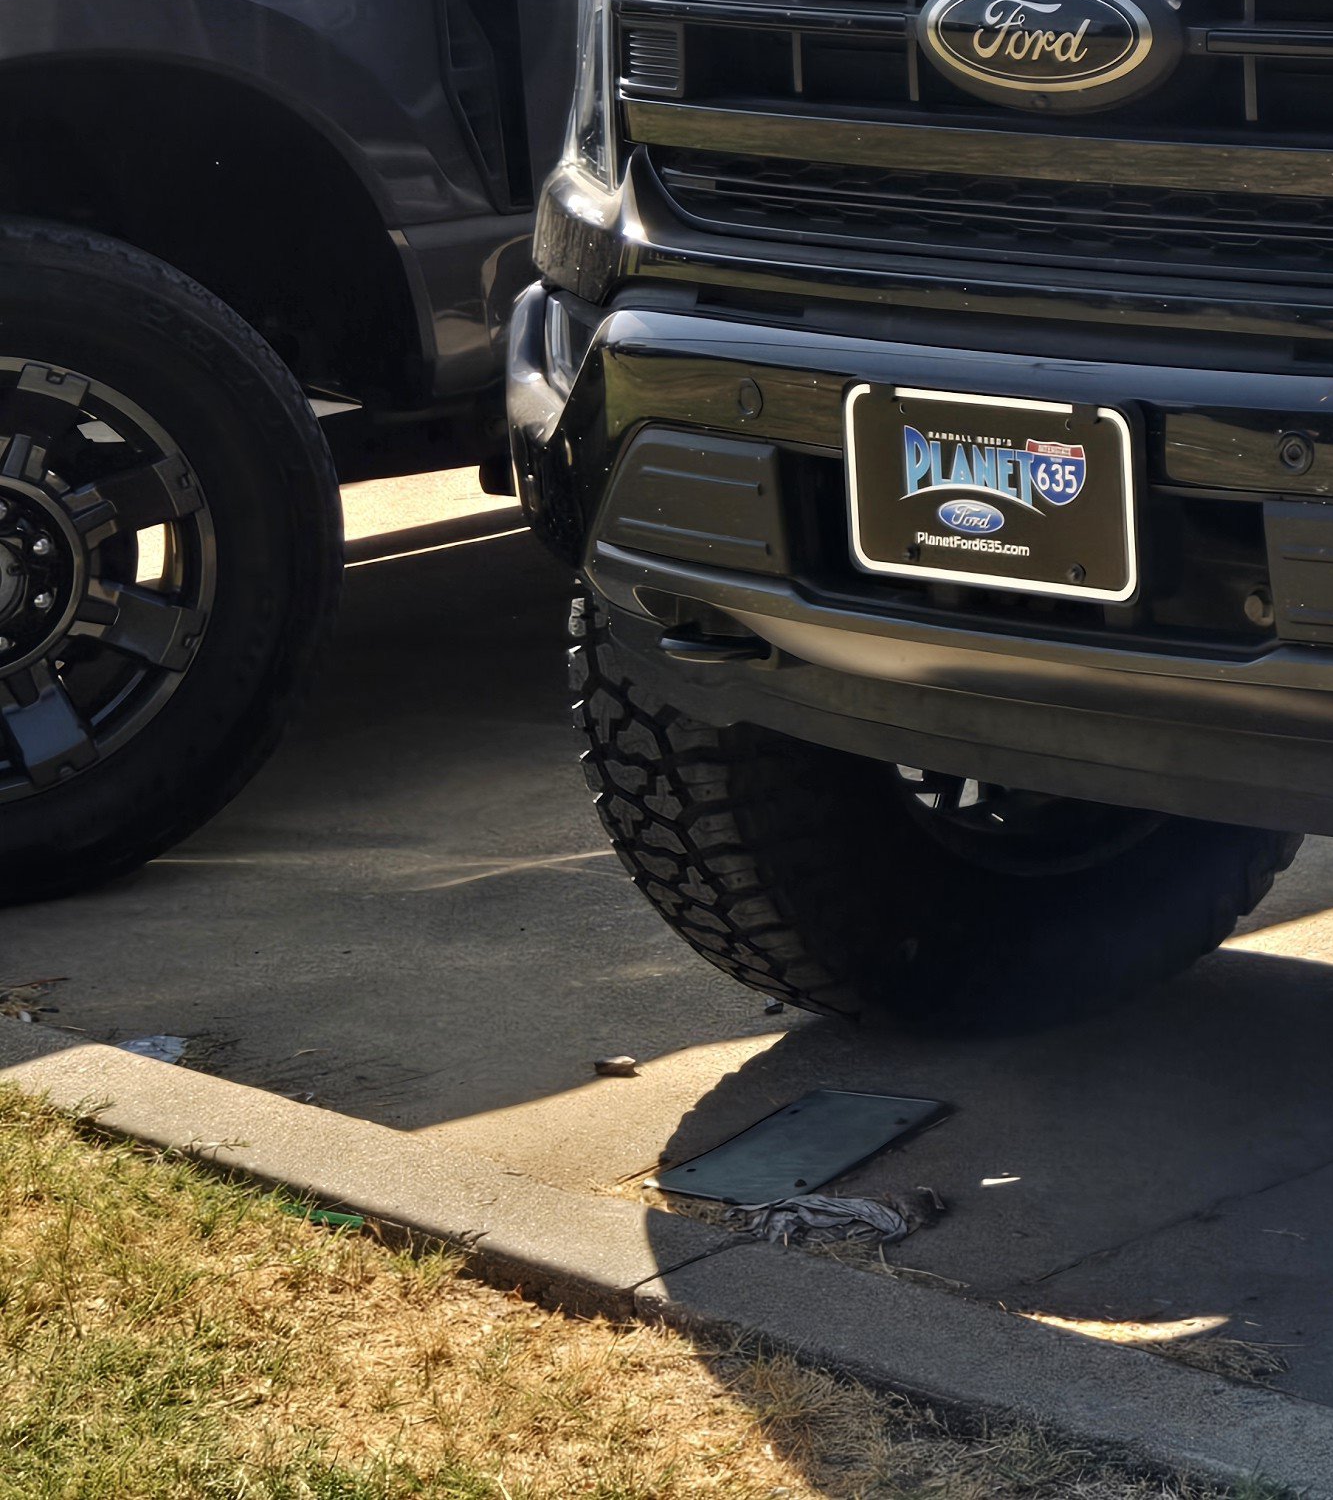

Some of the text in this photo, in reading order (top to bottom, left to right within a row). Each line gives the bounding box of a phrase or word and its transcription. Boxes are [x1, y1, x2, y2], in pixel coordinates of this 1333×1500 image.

[927, 431, 972, 443] RANDALL
[903, 424, 1035, 508] PLANET
[1037, 463, 1078, 494] 635
[952, 505, 990, 530] Ford
[916, 531, 1030, 557] PlanetFord635.com
